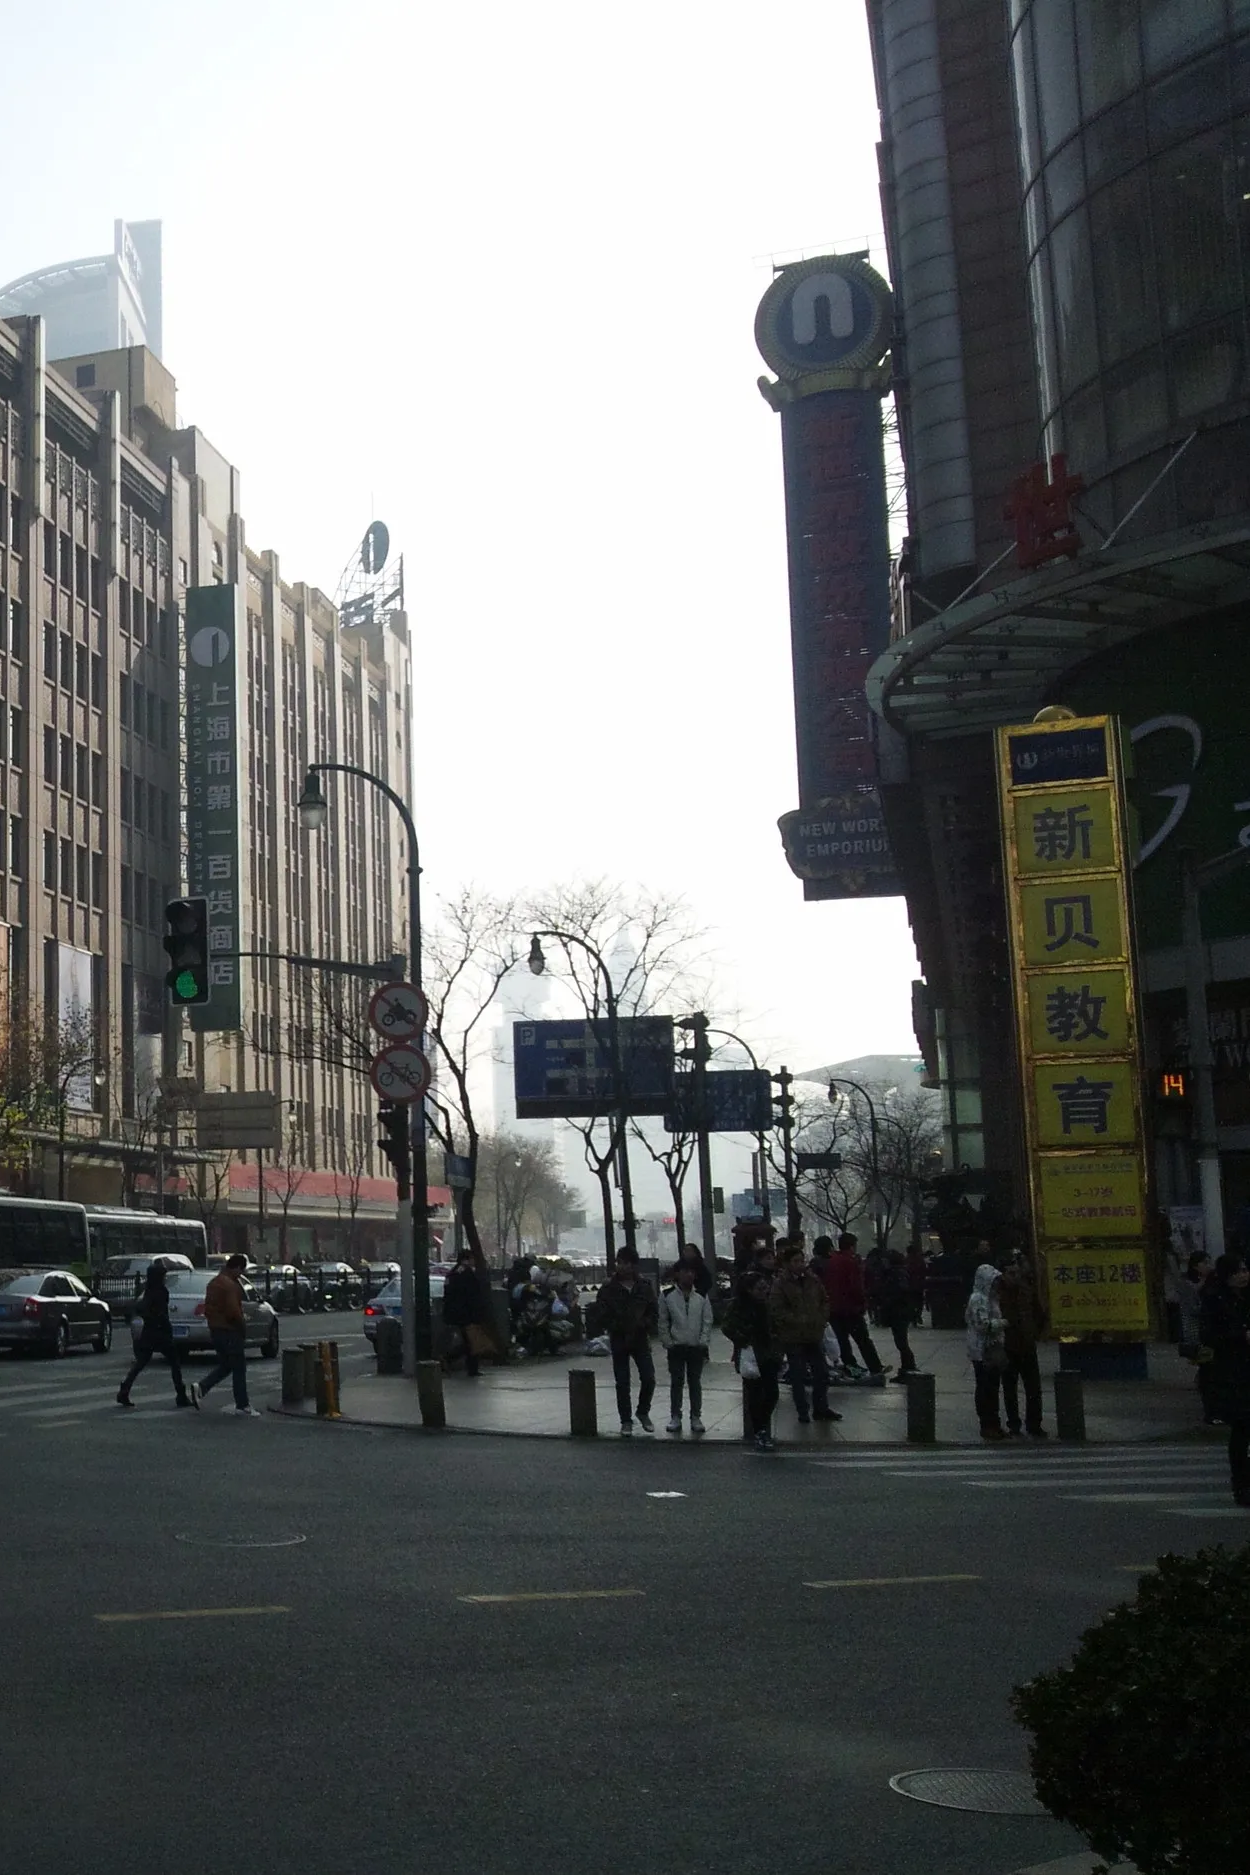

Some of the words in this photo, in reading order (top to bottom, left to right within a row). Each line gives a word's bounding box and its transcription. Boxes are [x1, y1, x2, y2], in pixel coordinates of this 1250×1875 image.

[192, 683, 202, 766] SHANGHAI
[194, 821, 203, 895] DEPARTM
[206, 681, 234, 986] 上海市第一百货商店
[799, 820, 837, 837] NEW
[842, 817, 887, 834] WOR
[1032, 804, 1115, 1135] 新贝教育
[1161, 1073, 1186, 1097] 14
